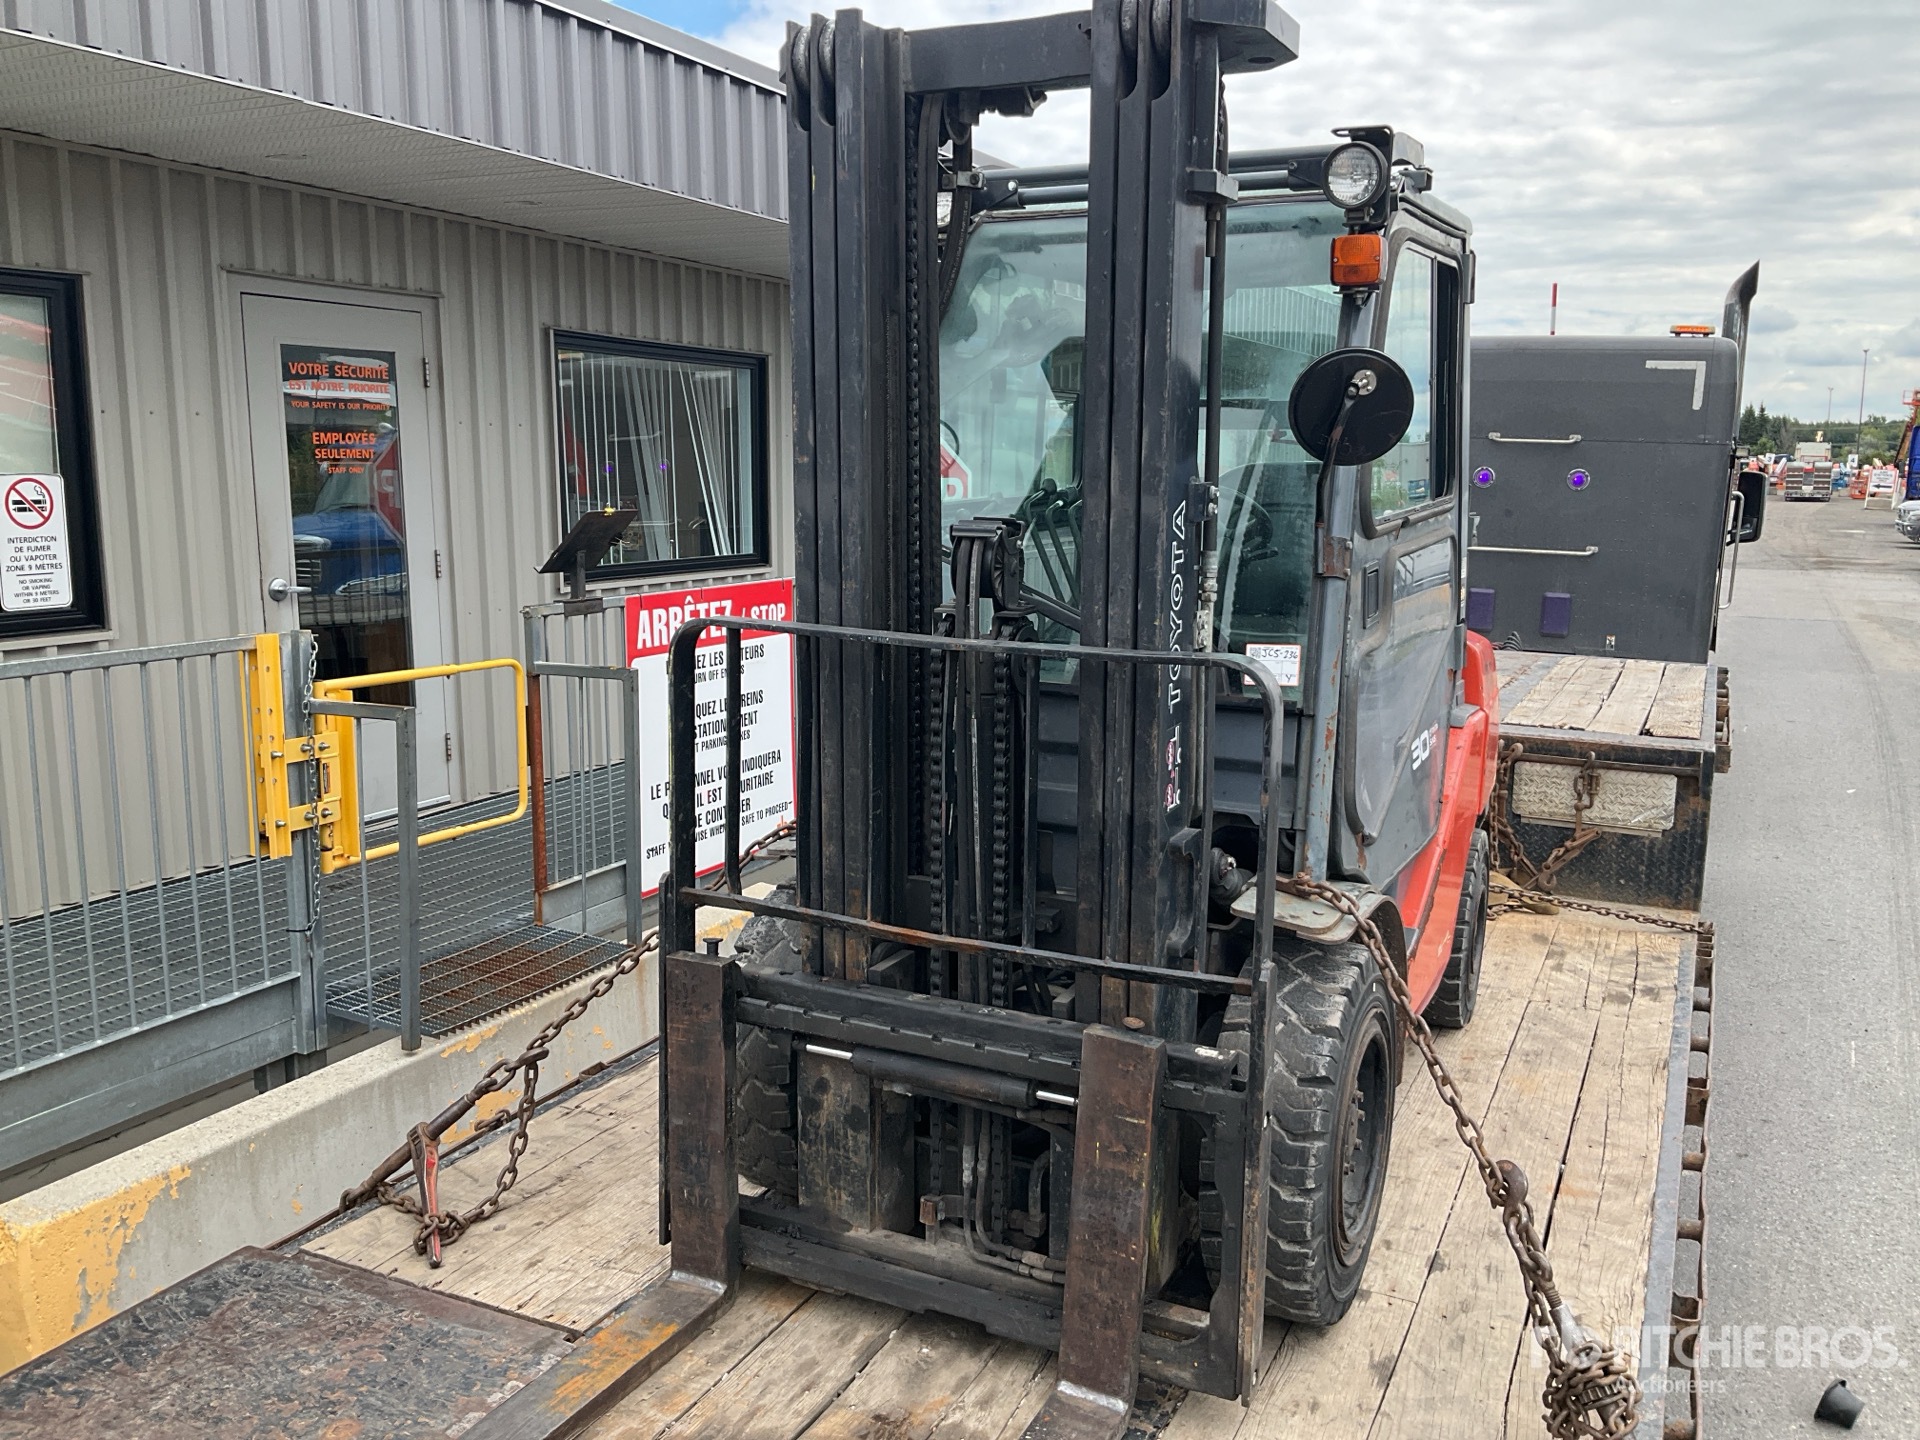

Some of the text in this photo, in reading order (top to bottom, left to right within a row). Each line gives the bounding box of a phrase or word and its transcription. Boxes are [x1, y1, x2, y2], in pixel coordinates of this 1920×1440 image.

[288, 362, 329, 377] VOTRE
[288, 380, 307, 390] EST
[311, 381, 345, 391] NOTRE
[291, 400, 309, 408] YOUR
[312, 401, 336, 410] SAFETY
[363, 403, 390, 411] PRIORITY
[312, 430, 376, 445] EMPLOYÉS
[315, 449, 375, 459] SEULEMENT
[7, 536, 57, 544] INTERDICTION
[1168, 500, 1186, 714] TOYOTA
[637, 595, 733, 650] ARRÊTEZ
[750, 603, 786, 622] STOP
[709, 651, 724, 667] LES
[708, 669, 719, 681] OFF
[741, 689, 764, 707] REINS
[701, 736, 727, 752] PARKING
[1411, 729, 1430, 771] 30
[651, 784, 662, 800] LE
[742, 749, 782, 773] INDIQUERA
[707, 787, 722, 804] EST
[646, 843, 666, 860] STAFF
[741, 813, 755, 826] SAFE
[756, 809, 764, 821] TO
[765, 801, 789, 818] PROCEED
